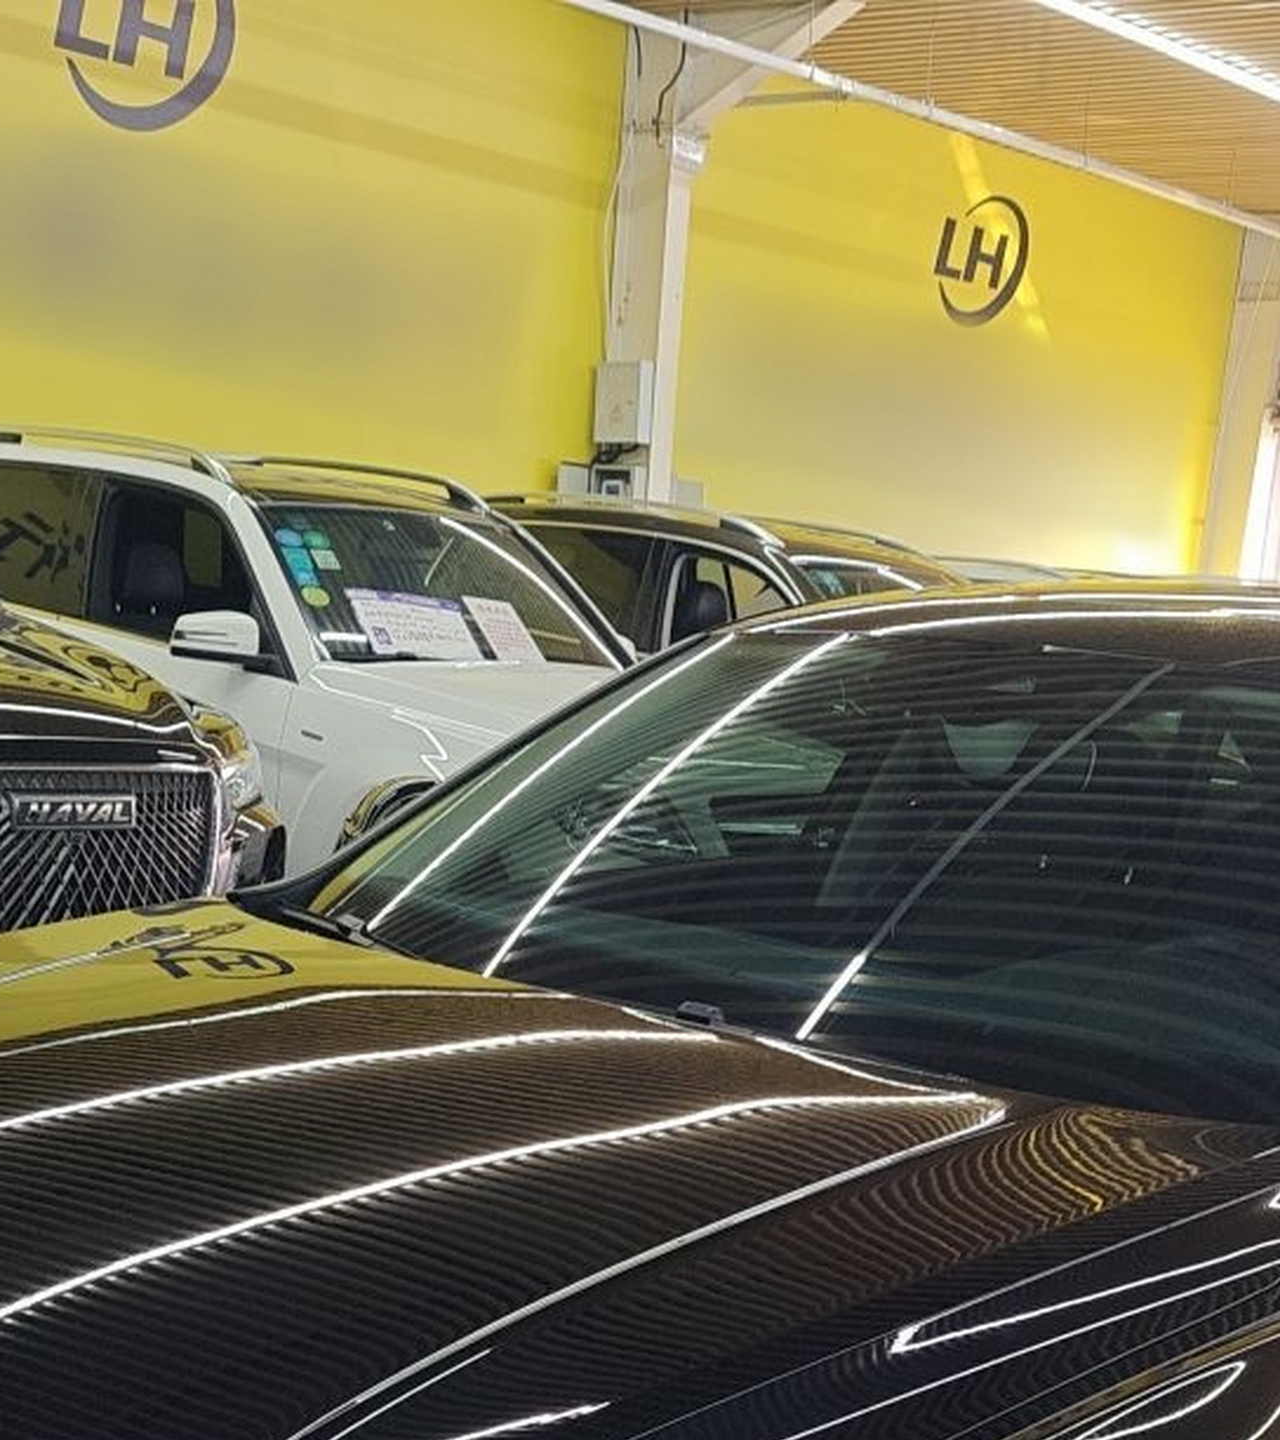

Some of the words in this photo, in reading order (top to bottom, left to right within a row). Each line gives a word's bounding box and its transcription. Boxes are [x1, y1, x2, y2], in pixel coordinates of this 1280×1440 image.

[54, 0, 196, 80] LH
[933, 216, 1009, 290] LH
[25, 801, 130, 823] HAVAL
